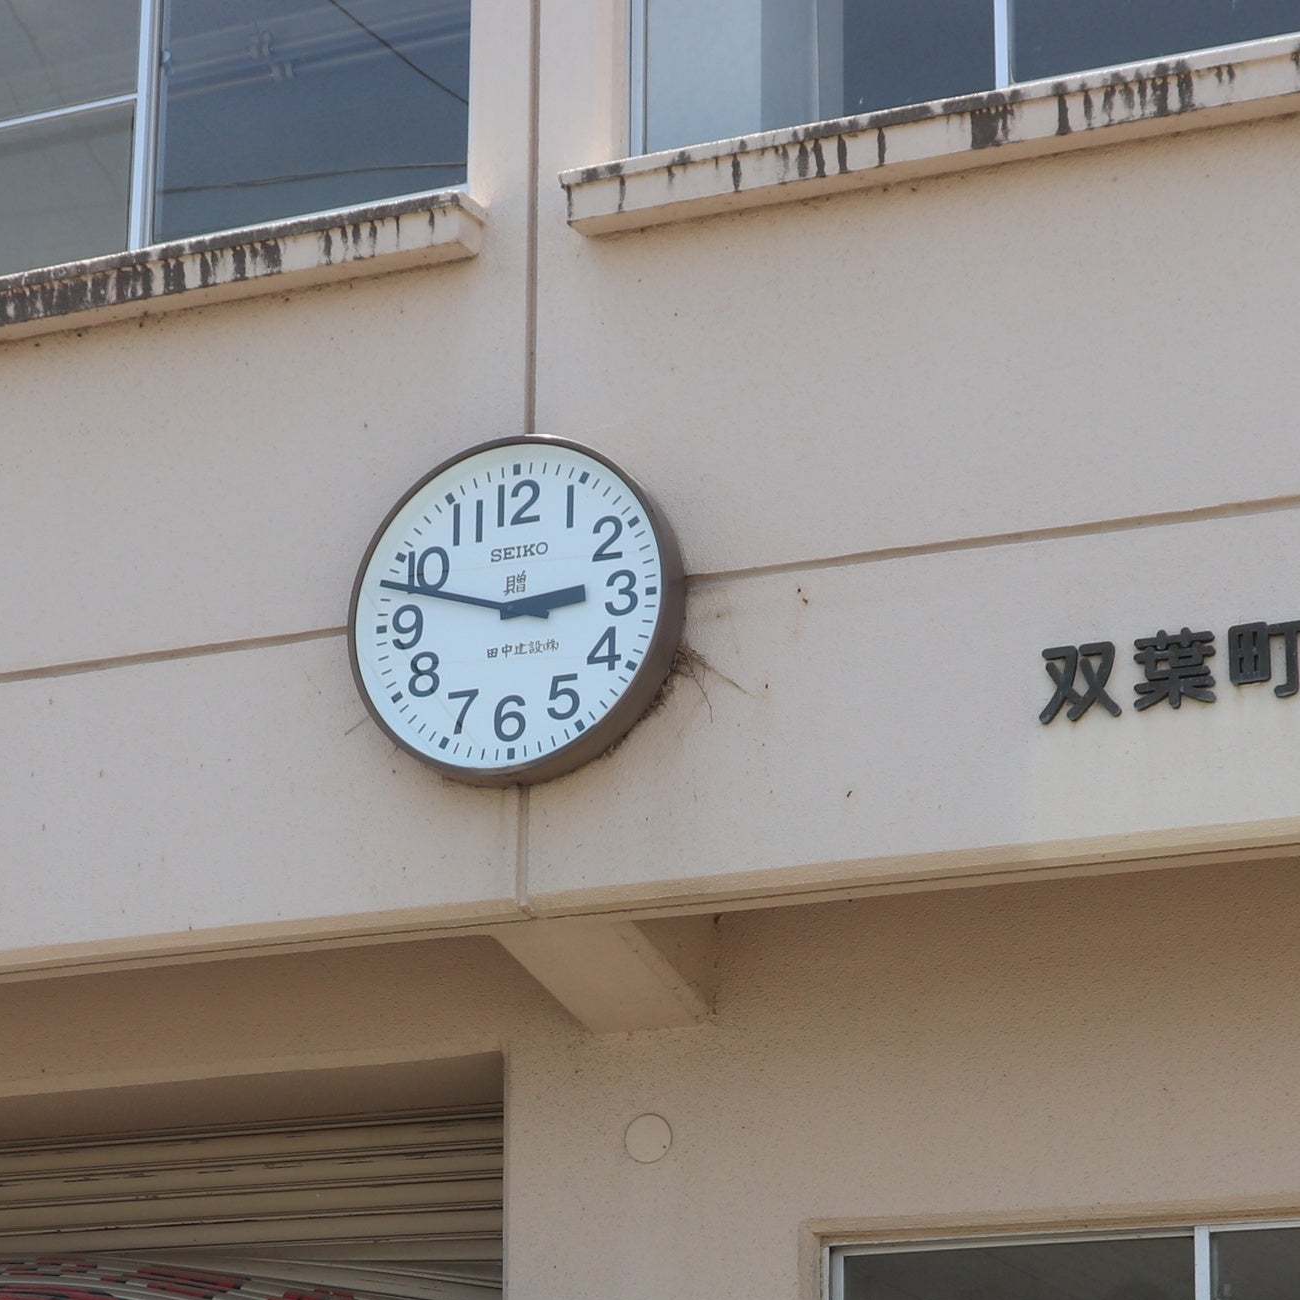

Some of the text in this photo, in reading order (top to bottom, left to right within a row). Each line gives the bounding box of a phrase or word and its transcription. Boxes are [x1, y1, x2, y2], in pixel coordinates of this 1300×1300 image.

[453, 499, 484, 547] 11
[497, 479, 541, 528] 12
[566, 484, 575, 529] 1
[490, 541, 548, 563] SEIKO
[592, 515, 624, 562] 2
[407, 546, 450, 594] 10
[503, 570, 527, 596] 贈
[605, 569, 638, 617] 3
[392, 604, 424, 650] 9
[586, 626, 622, 671] 4
[407, 651, 440, 698] 8
[547, 673, 581, 720] 5
[448, 688, 479, 735] 7
[494, 694, 526, 742] 6
